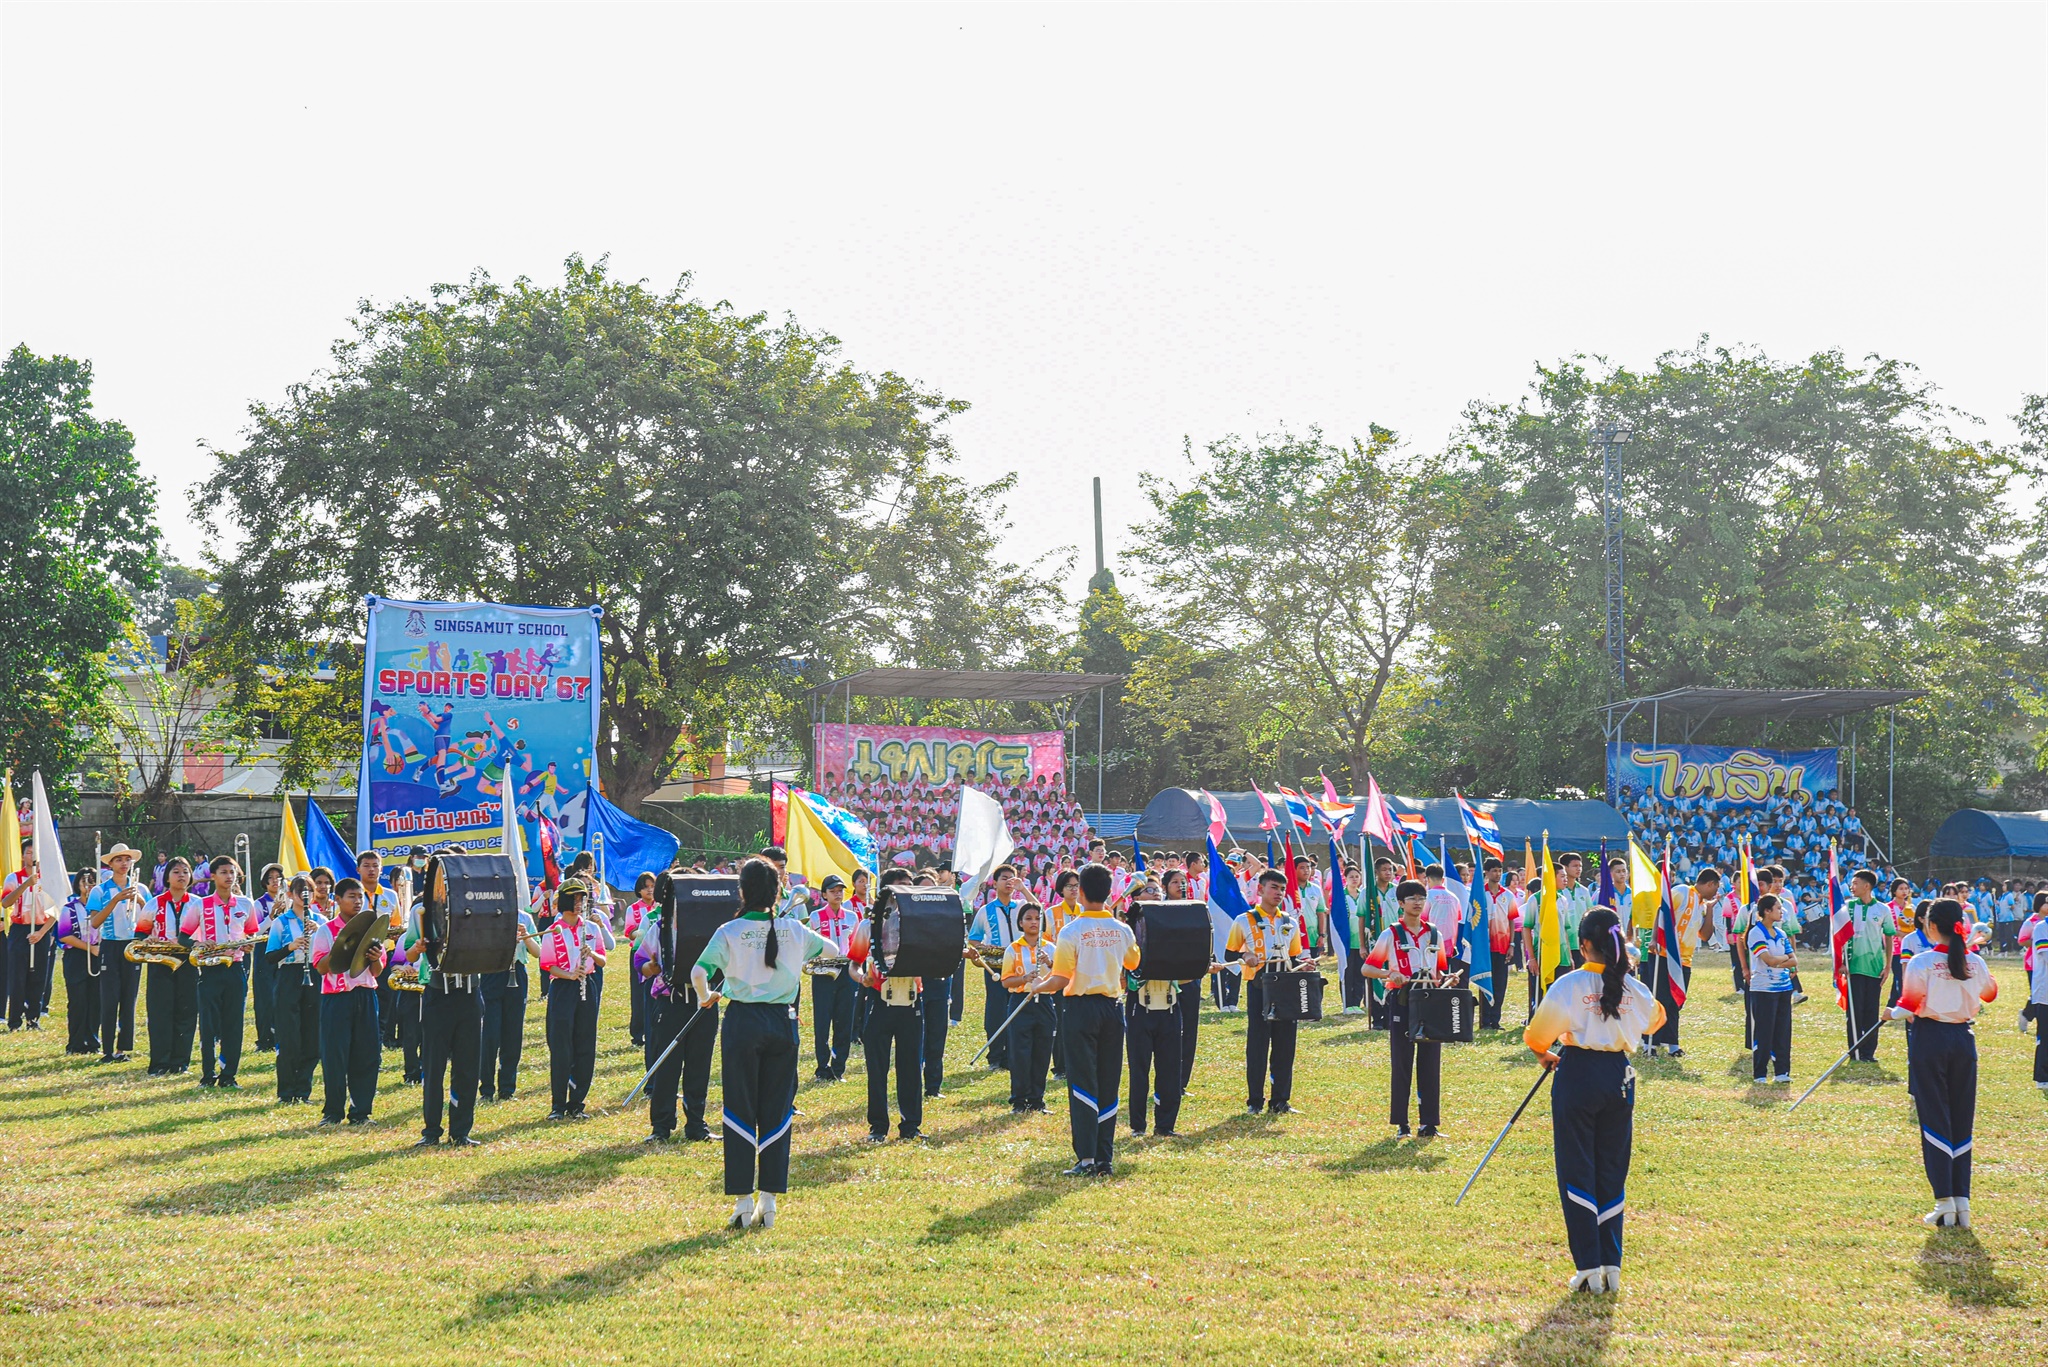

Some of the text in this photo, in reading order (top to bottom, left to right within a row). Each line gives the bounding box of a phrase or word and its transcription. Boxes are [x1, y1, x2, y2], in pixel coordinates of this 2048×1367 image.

[434, 619, 514, 635] SINGSAMUT
[518, 623, 569, 637] SCHOOL
[378, 669, 590, 700] SPORTS DAY 67
[1632, 750, 1811, 808] ไพลิน
[474, 891, 504, 900] YAMAHA
[699, 889, 731, 897] YAMAHA
[919, 894, 947, 902] YAMAHA
[204, 907, 216, 941] DIAM
[988, 914, 1000, 944] SAPP
[553, 933, 570, 971] DIAM
[1252, 924, 1264, 958] TOP
[1300, 987, 1309, 1013] YAMAHA
[1452, 1006, 1461, 1034] YAMAHA
